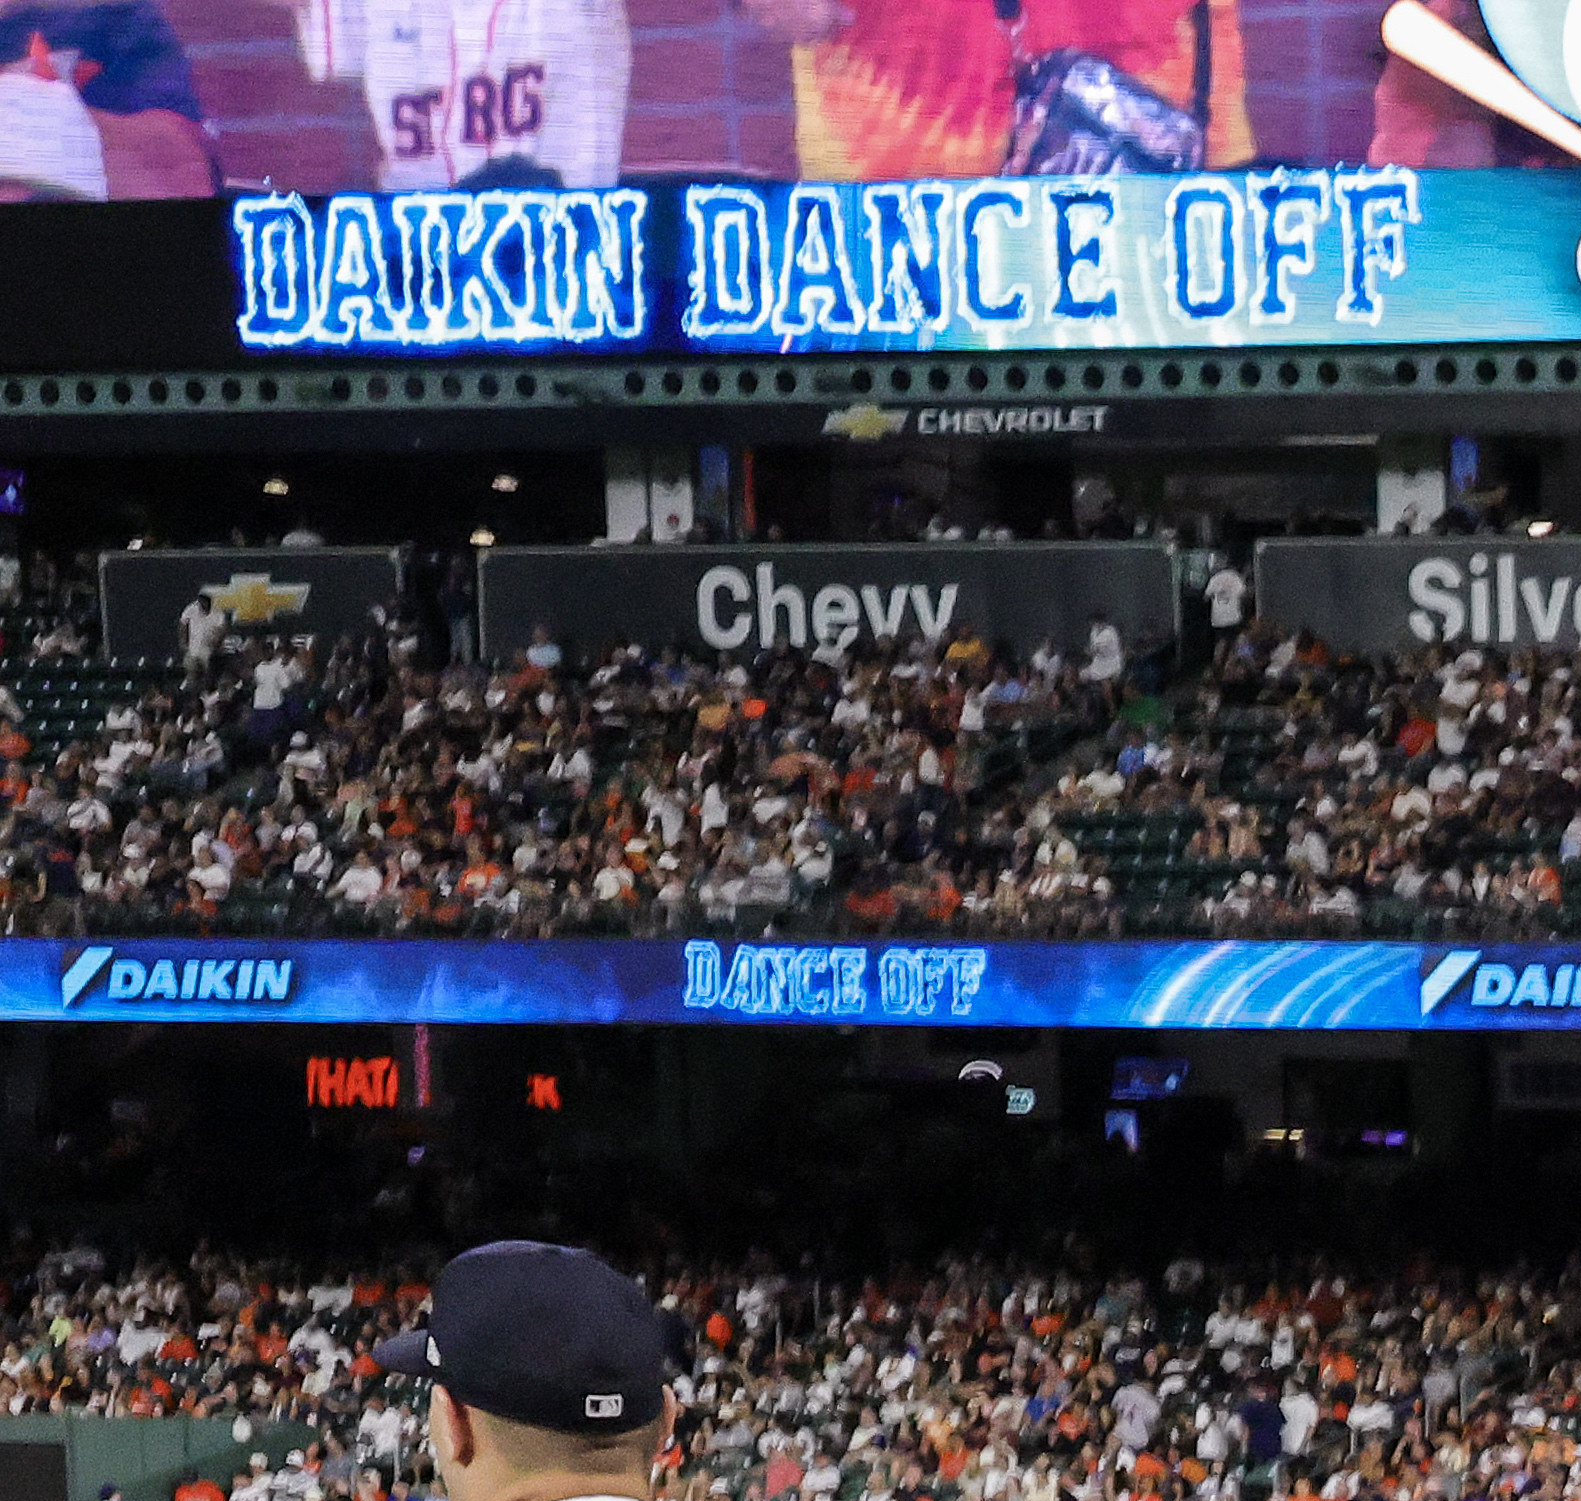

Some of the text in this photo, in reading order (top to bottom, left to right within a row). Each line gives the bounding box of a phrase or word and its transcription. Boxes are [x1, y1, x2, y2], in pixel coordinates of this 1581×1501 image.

[233, 165, 1421, 347] DAIKIN DANCE OFF
[917, 405, 1110, 434] CHEVROLET
[107, 958, 294, 1001] DAIKIN
[684, 939, 988, 1016] DANCE OFF
